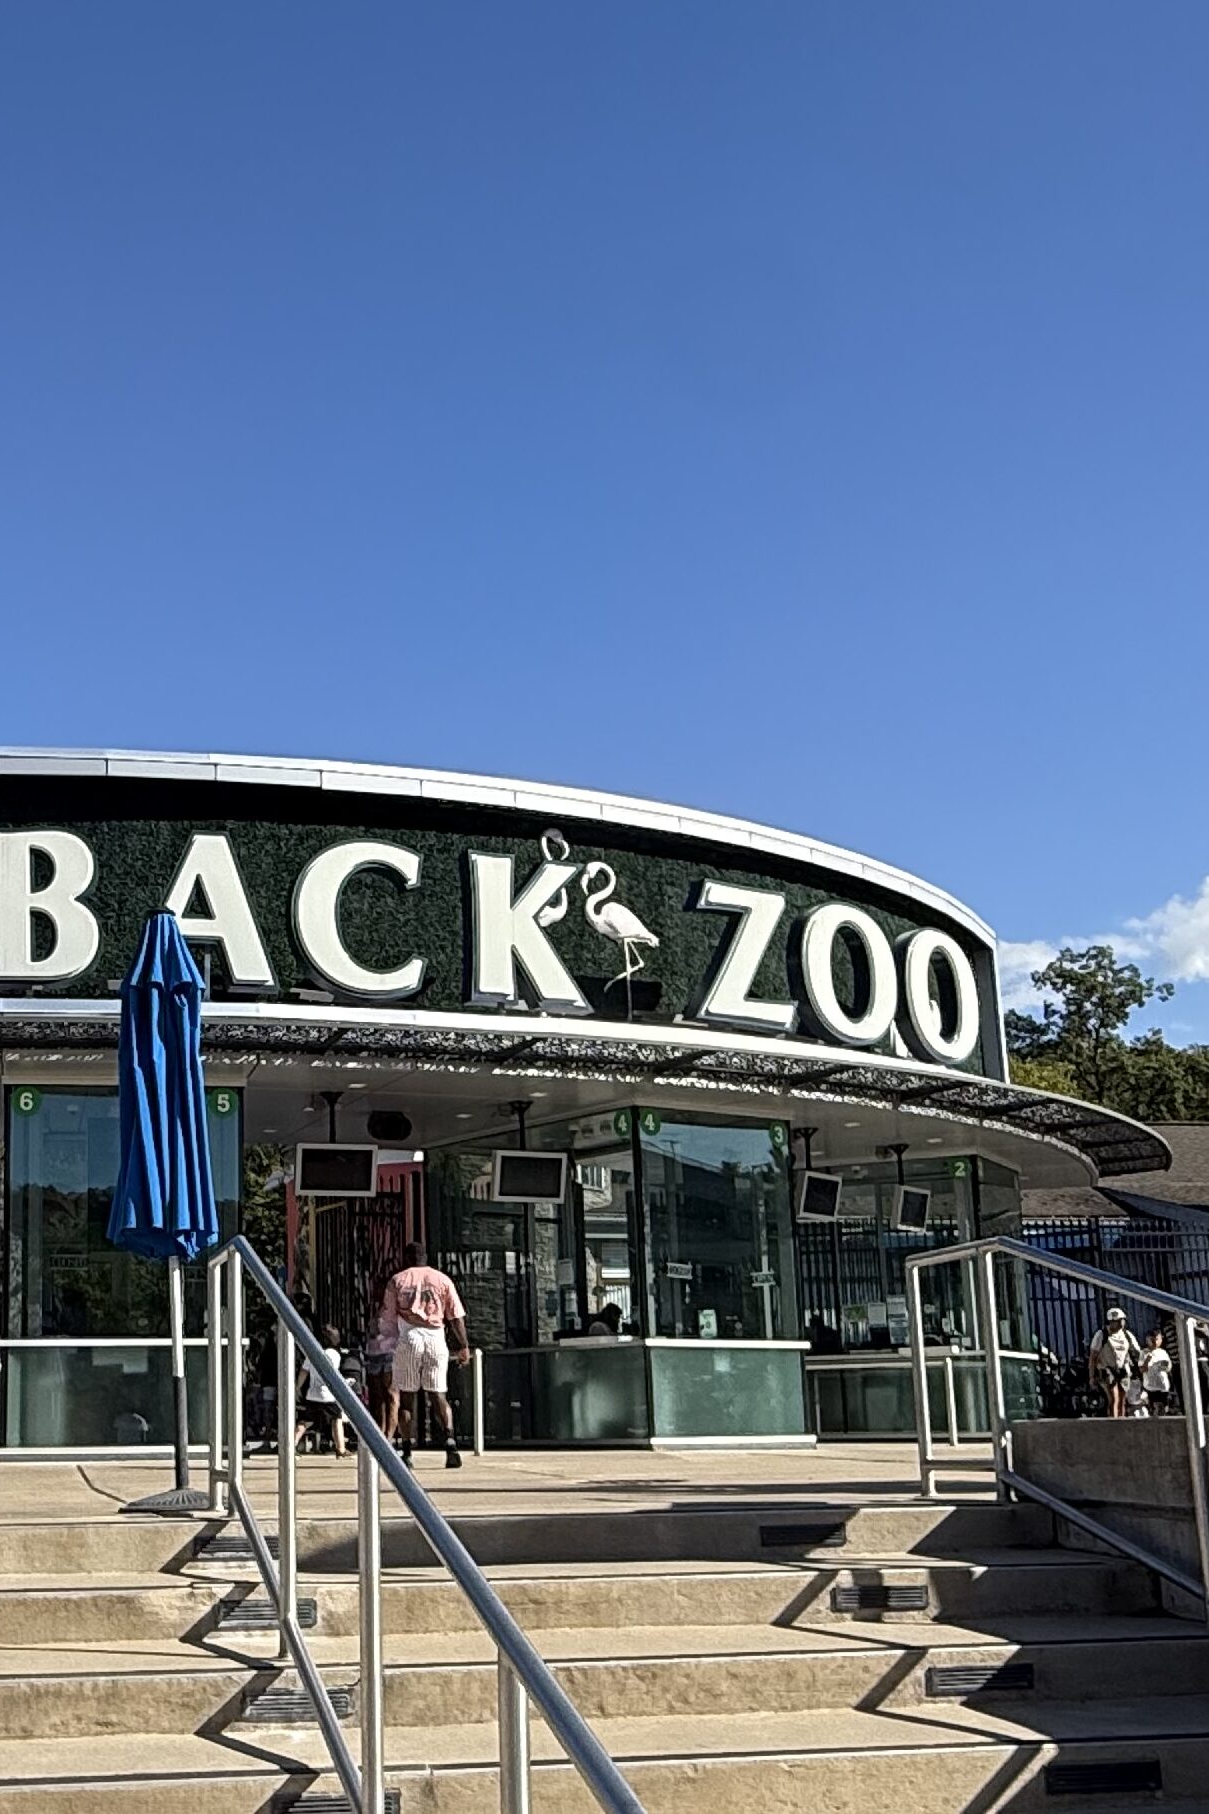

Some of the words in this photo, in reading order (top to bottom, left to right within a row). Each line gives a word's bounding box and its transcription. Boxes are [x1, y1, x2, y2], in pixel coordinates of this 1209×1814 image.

[698, 878, 980, 1064] ZOO
[19, 1092, 33, 1111] 6
[217, 1093, 230, 1113] 5
[618, 1114, 627, 1131] 4
[645, 1113, 655, 1131] 4
[774, 1126, 783, 1143] 3
[954, 1161, 966, 1177] 2
